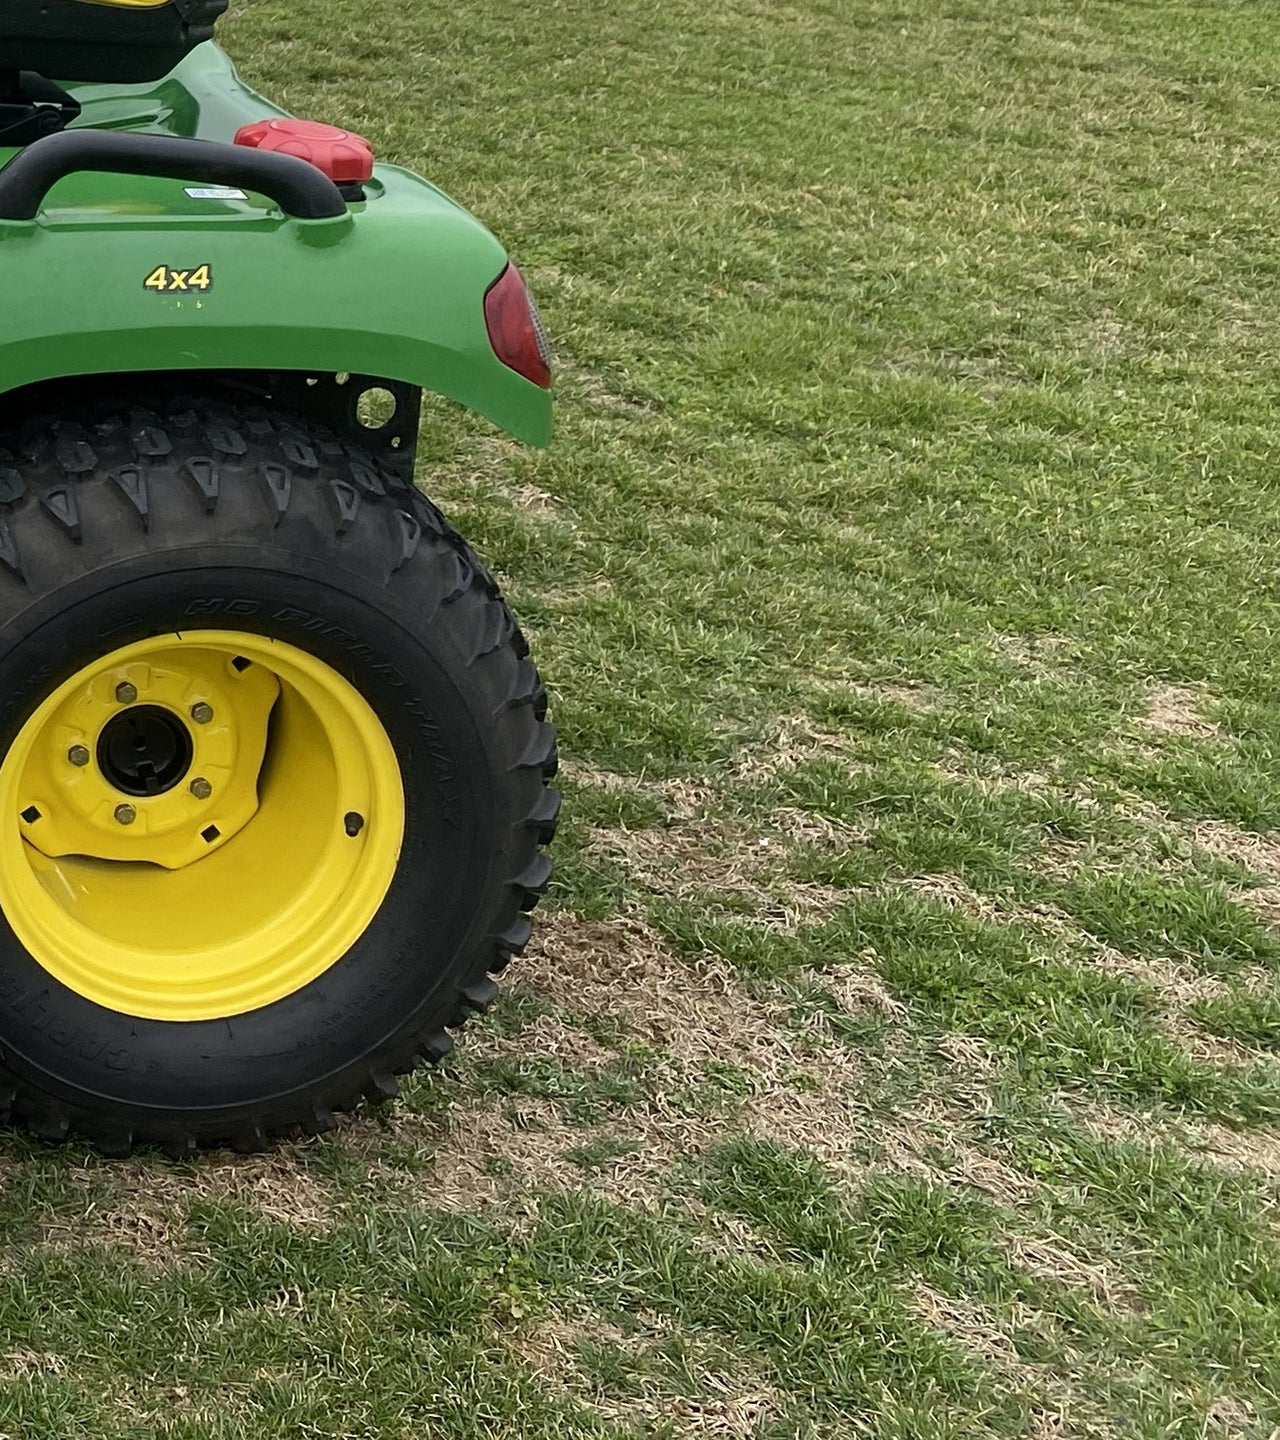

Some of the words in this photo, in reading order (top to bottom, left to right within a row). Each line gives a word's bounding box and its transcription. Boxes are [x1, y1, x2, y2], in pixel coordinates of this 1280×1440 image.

[144, 265, 211, 291] 4x4
[184, 598, 261, 616] HD
[272, 608, 408, 687] FIELD
